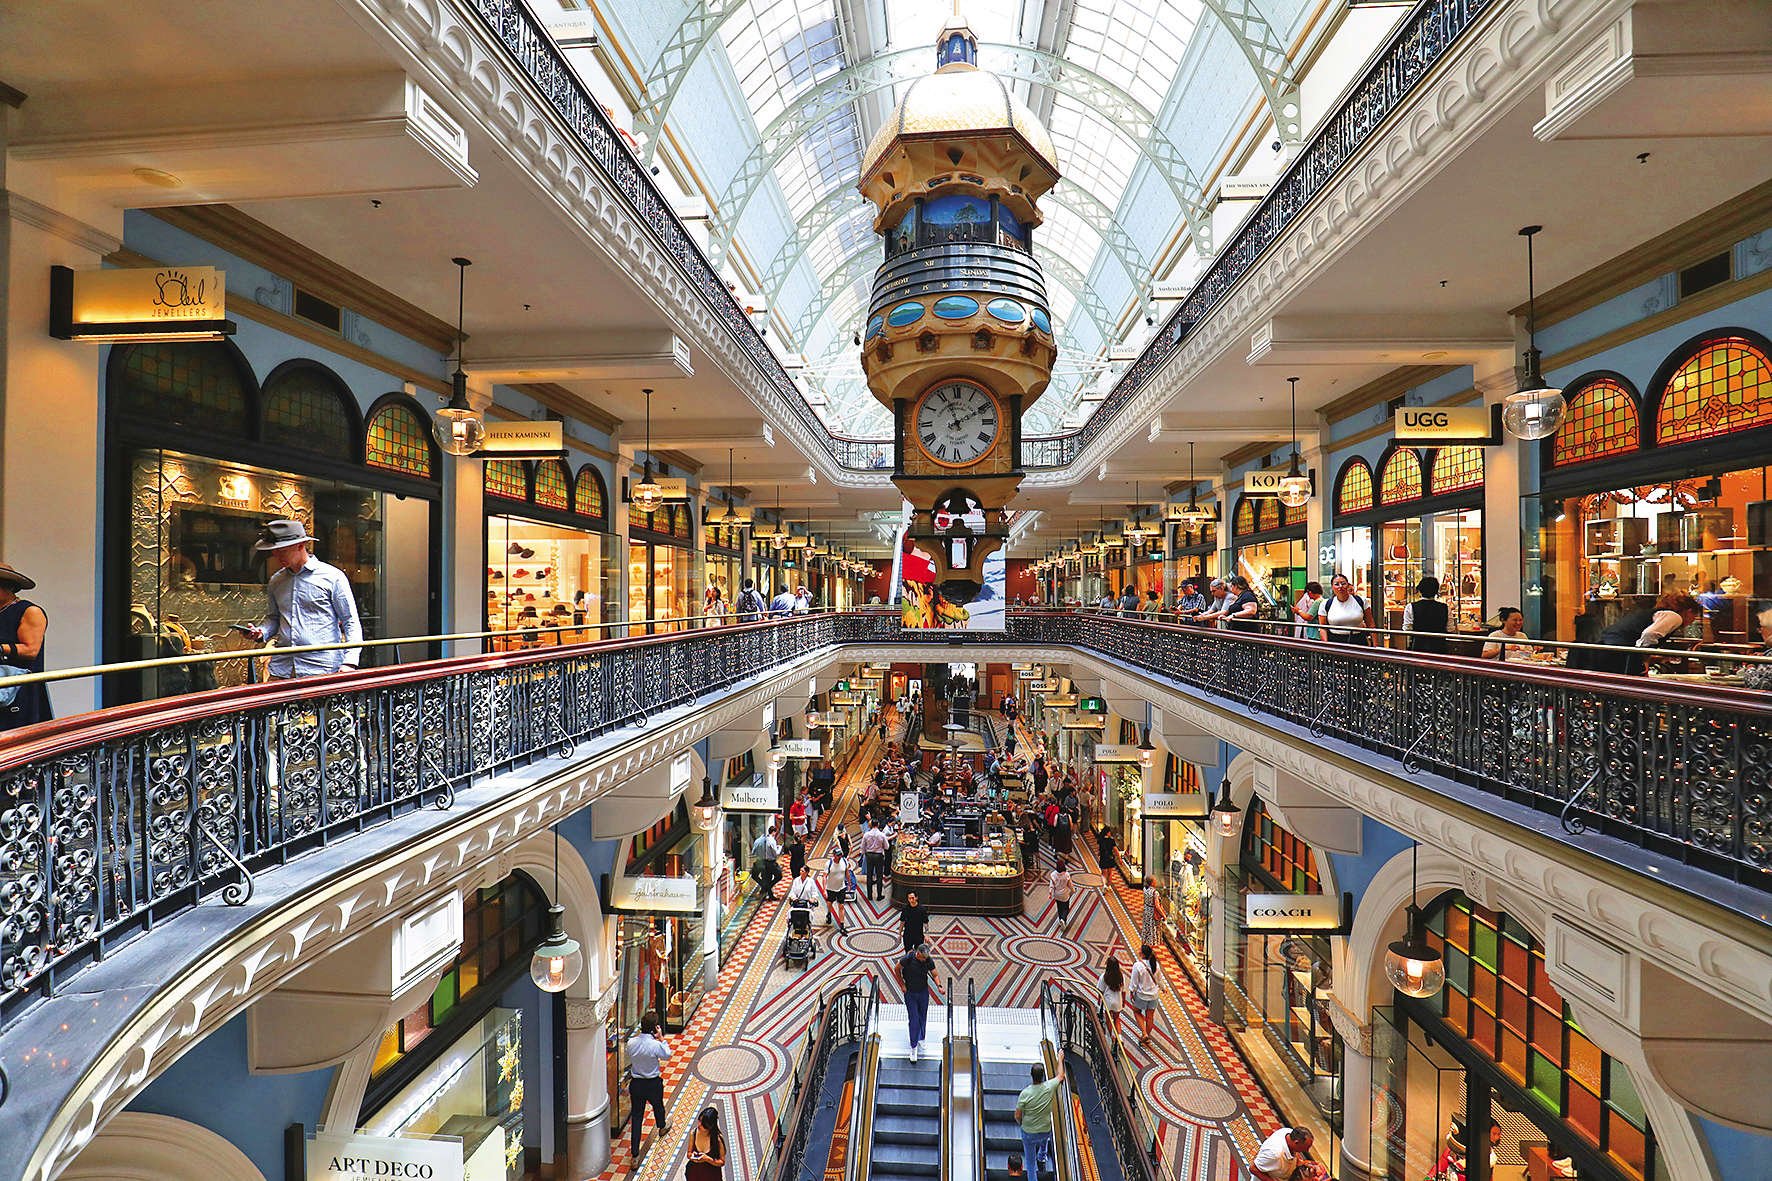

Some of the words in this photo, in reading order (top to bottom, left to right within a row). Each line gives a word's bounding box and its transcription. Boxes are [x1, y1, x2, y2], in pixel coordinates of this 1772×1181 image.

[152, 308, 206, 317] JEWELLERS
[1404, 412, 1448, 427] UGG
[784, 743, 812, 754] Mulberry
[731, 792, 767, 805] Mulberry
[1253, 908, 1312, 916] COACH
[328, 1156, 370, 1173] ART
[375, 1160, 433, 1179] DECO
